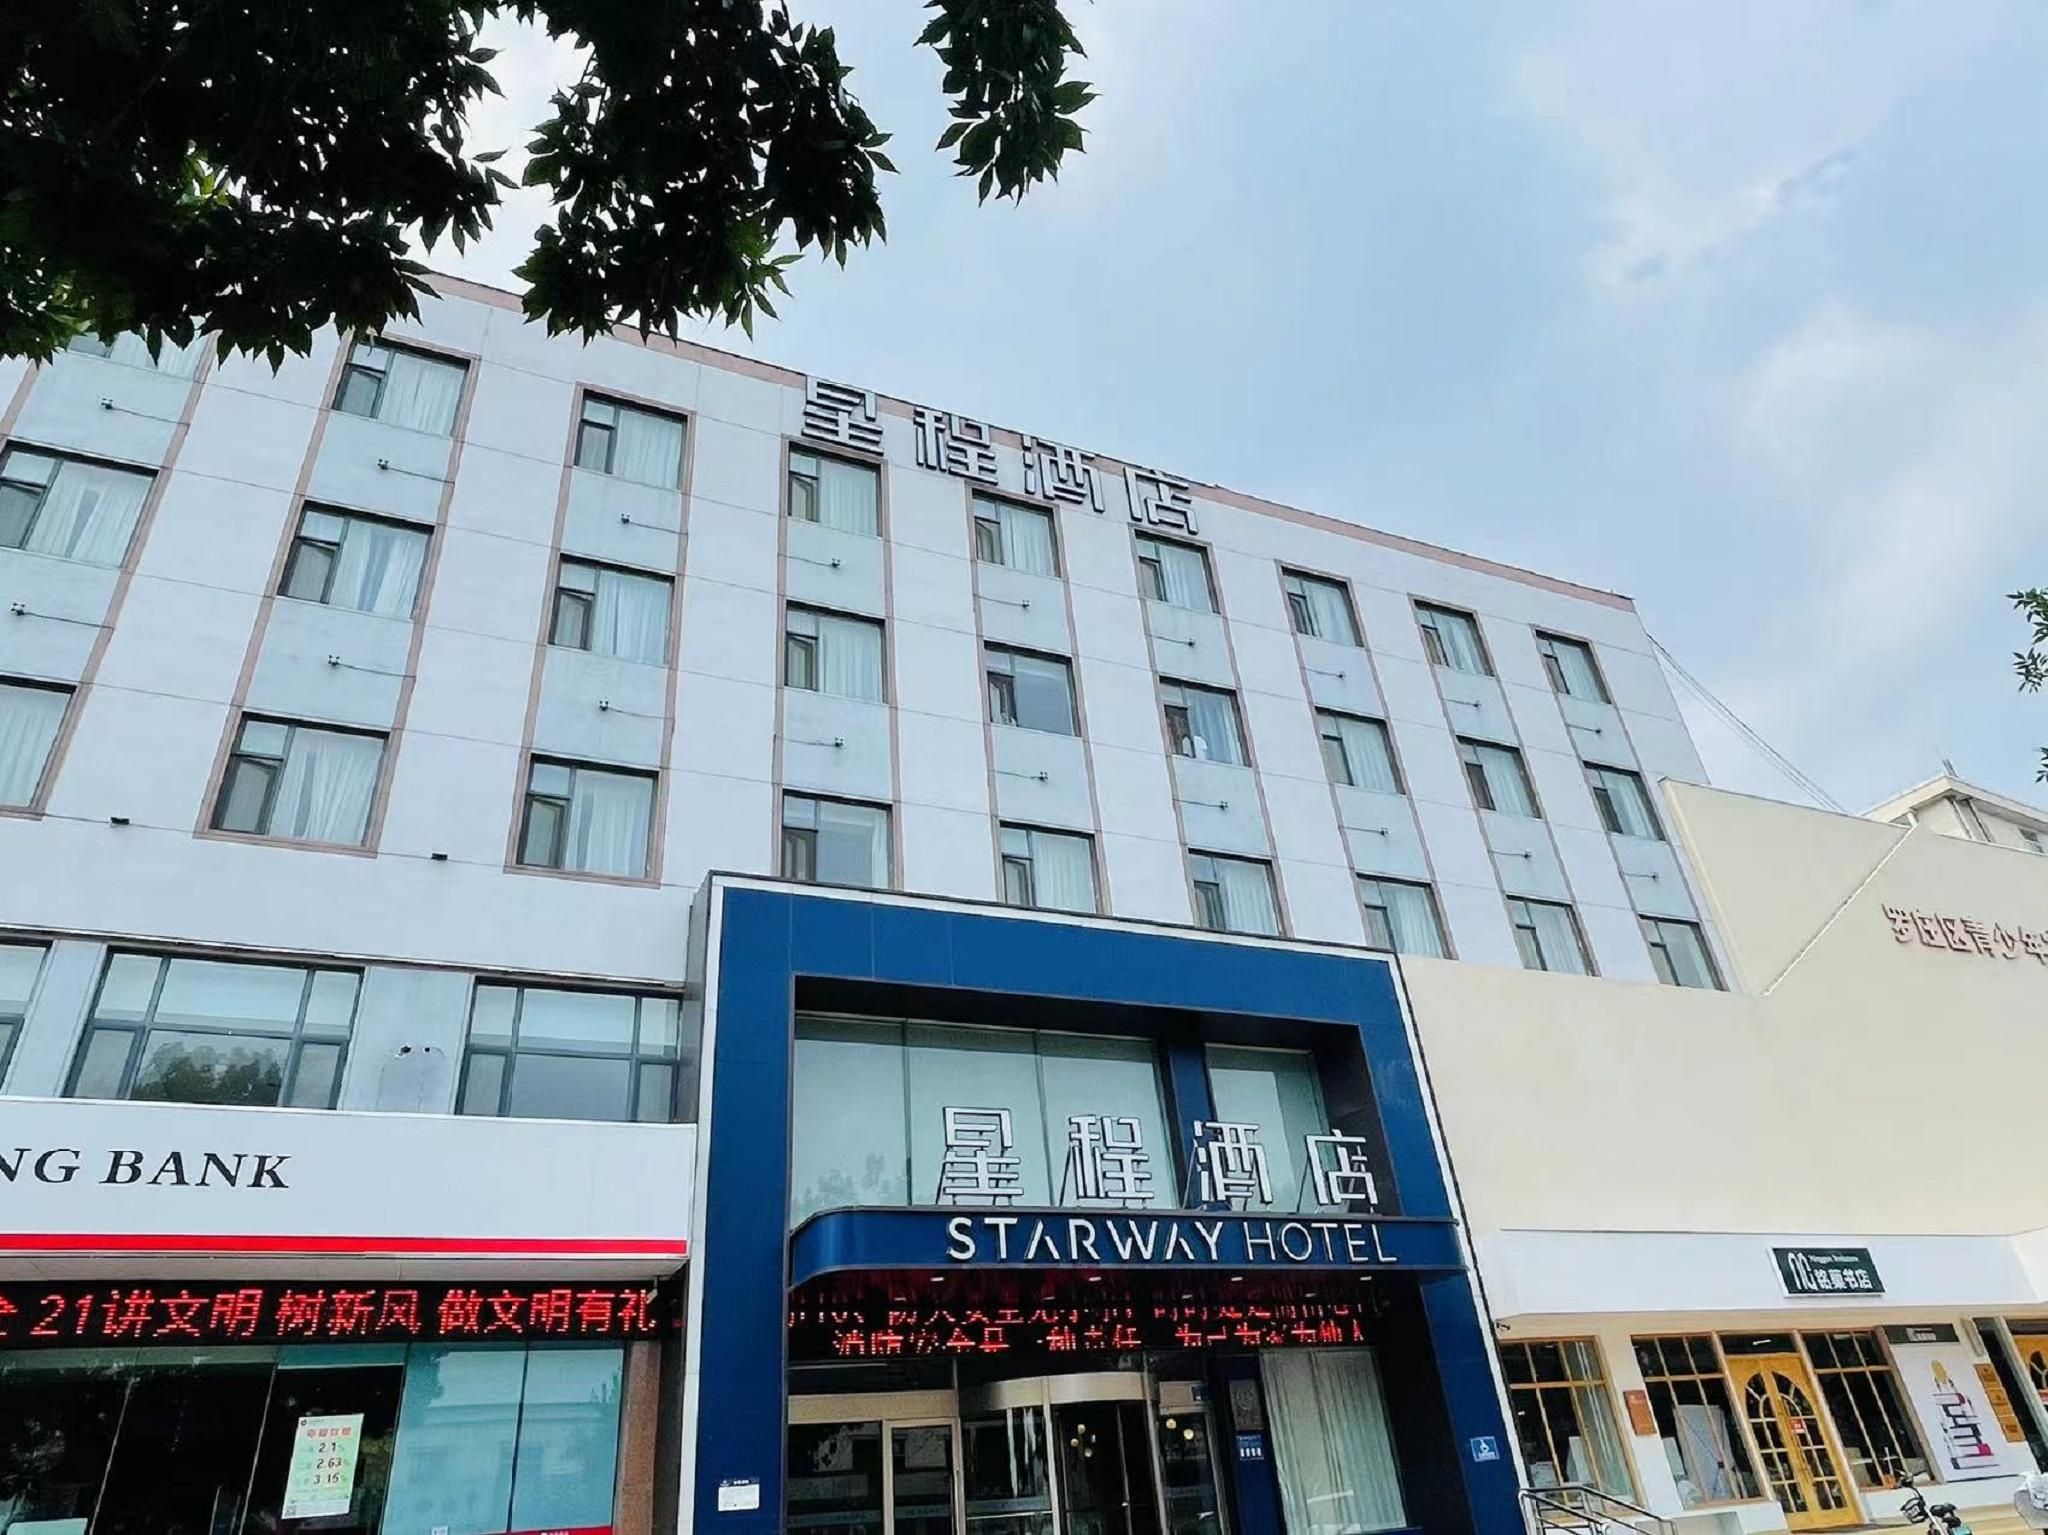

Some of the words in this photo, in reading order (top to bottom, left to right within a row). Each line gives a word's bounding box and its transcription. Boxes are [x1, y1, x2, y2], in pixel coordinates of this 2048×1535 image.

[801, 376, 1200, 535] 星程酒店
[1881, 903, 2048, 966] 罗庄区青少年
[98, 1150, 292, 1189] BANK
[941, 1105, 1379, 1206] 星程酒店
[947, 1216, 1225, 1262] STARWAY
[1243, 1221, 1398, 1263] HOTEL
[274, 1288, 421, 1336] 树新风
[437, 1288, 656, 1336] 做文明有礼
